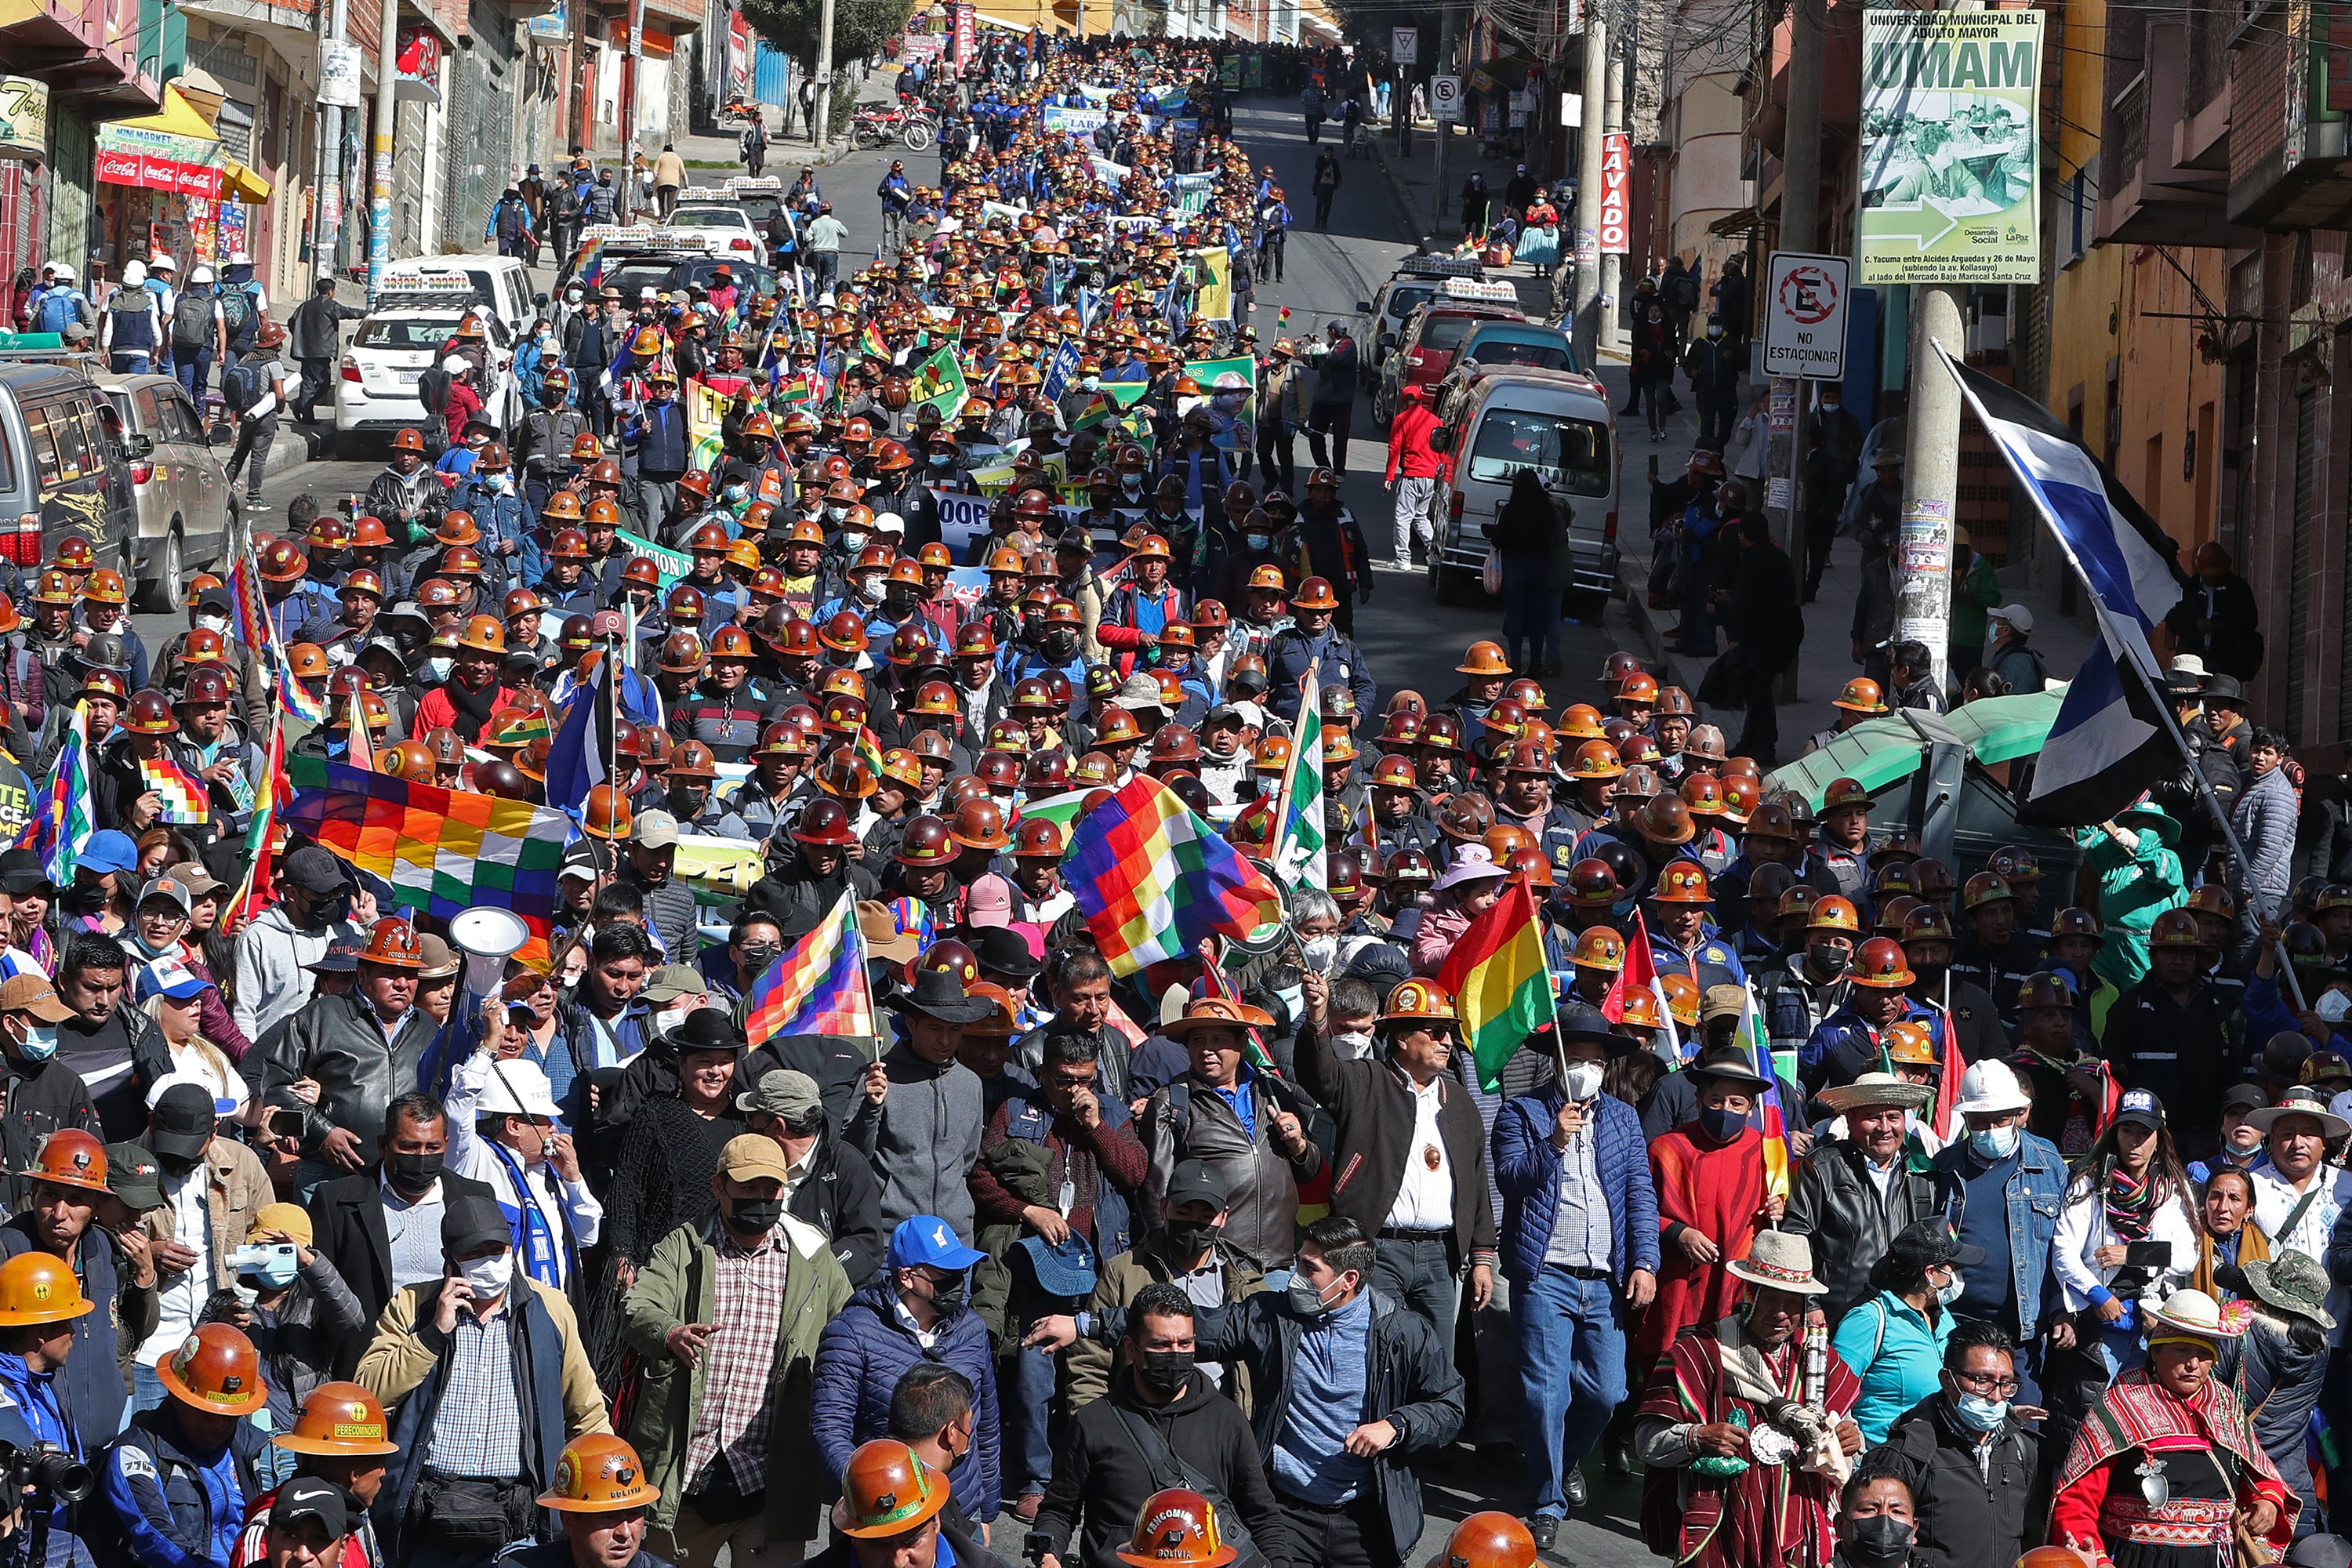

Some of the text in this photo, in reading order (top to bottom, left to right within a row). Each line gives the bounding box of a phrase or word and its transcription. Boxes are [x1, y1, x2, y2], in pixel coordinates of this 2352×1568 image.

[1870, 14, 2038, 27] UNIVERSIDAD MUNICIPAL DEL
[1912, 27, 1998, 39] ADULTO MAYOR
[1871, 42, 2033, 89] UMAM
[116, 128, 172, 144] MINI MARKET
[1602, 134, 1626, 244] LAVADO
[1951, 255, 1985, 264] Arguedas
[2016, 255, 2035, 263] Mayo
[1902, 264, 1937, 273] (subiendo
[1960, 264, 1998, 273] Kollasuyo)
[1797, 332, 1813, 344] NO
[1769, 347, 1838, 363] ESTACIONAR
[938, 499, 988, 525] OOP
[610, 1486, 641, 1498] BOLIVIA
[1158, 1548, 1192, 1560] BOLIVIA
